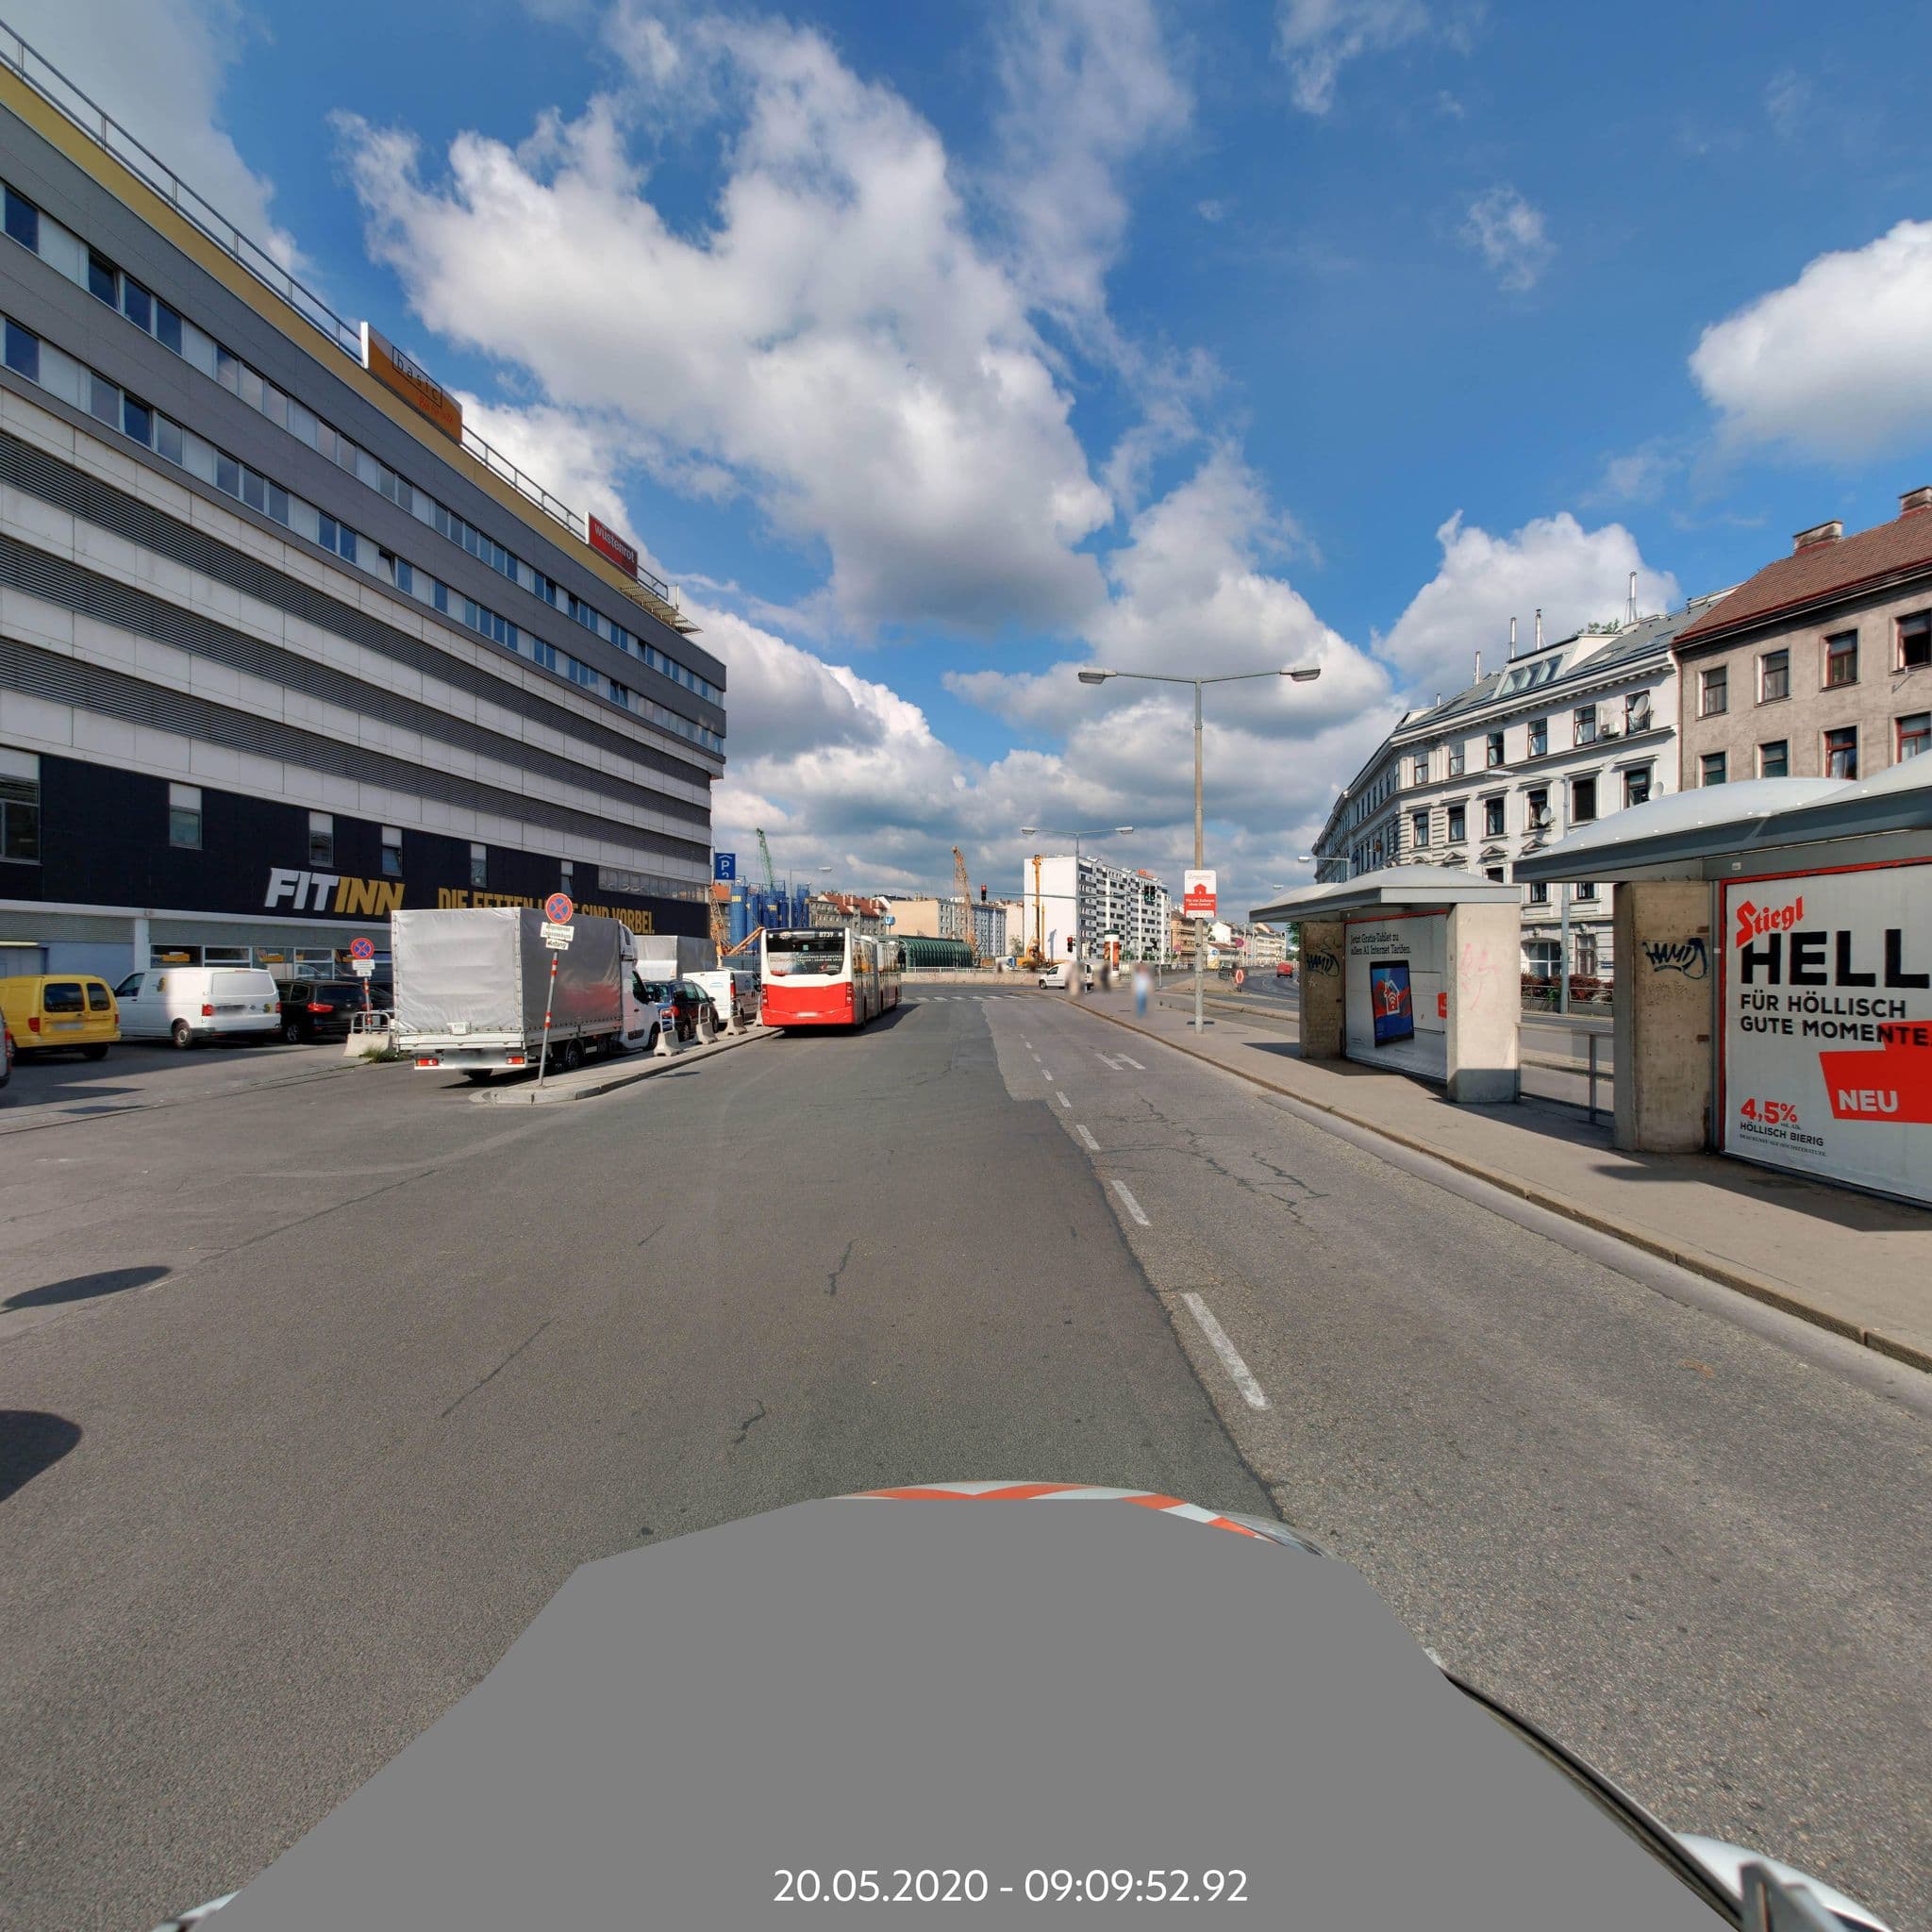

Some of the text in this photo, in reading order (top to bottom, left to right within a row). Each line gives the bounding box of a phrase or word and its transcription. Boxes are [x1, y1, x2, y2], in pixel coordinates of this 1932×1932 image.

[721, 859, 730, 871] P
[1736, 895, 1804, 948] Stiegl
[1740, 928, 1930, 989] HELL
[1740, 990, 1906, 1019] FÜR HÖLLISCH
[1740, 1016, 1793, 1035] GUTE
[1740, 1098, 1798, 1124] 4,5%
[1838, 1090, 1898, 1113] NEU
[1740, 1121, 1824, 1146] HÖLLISCH BIERIG
